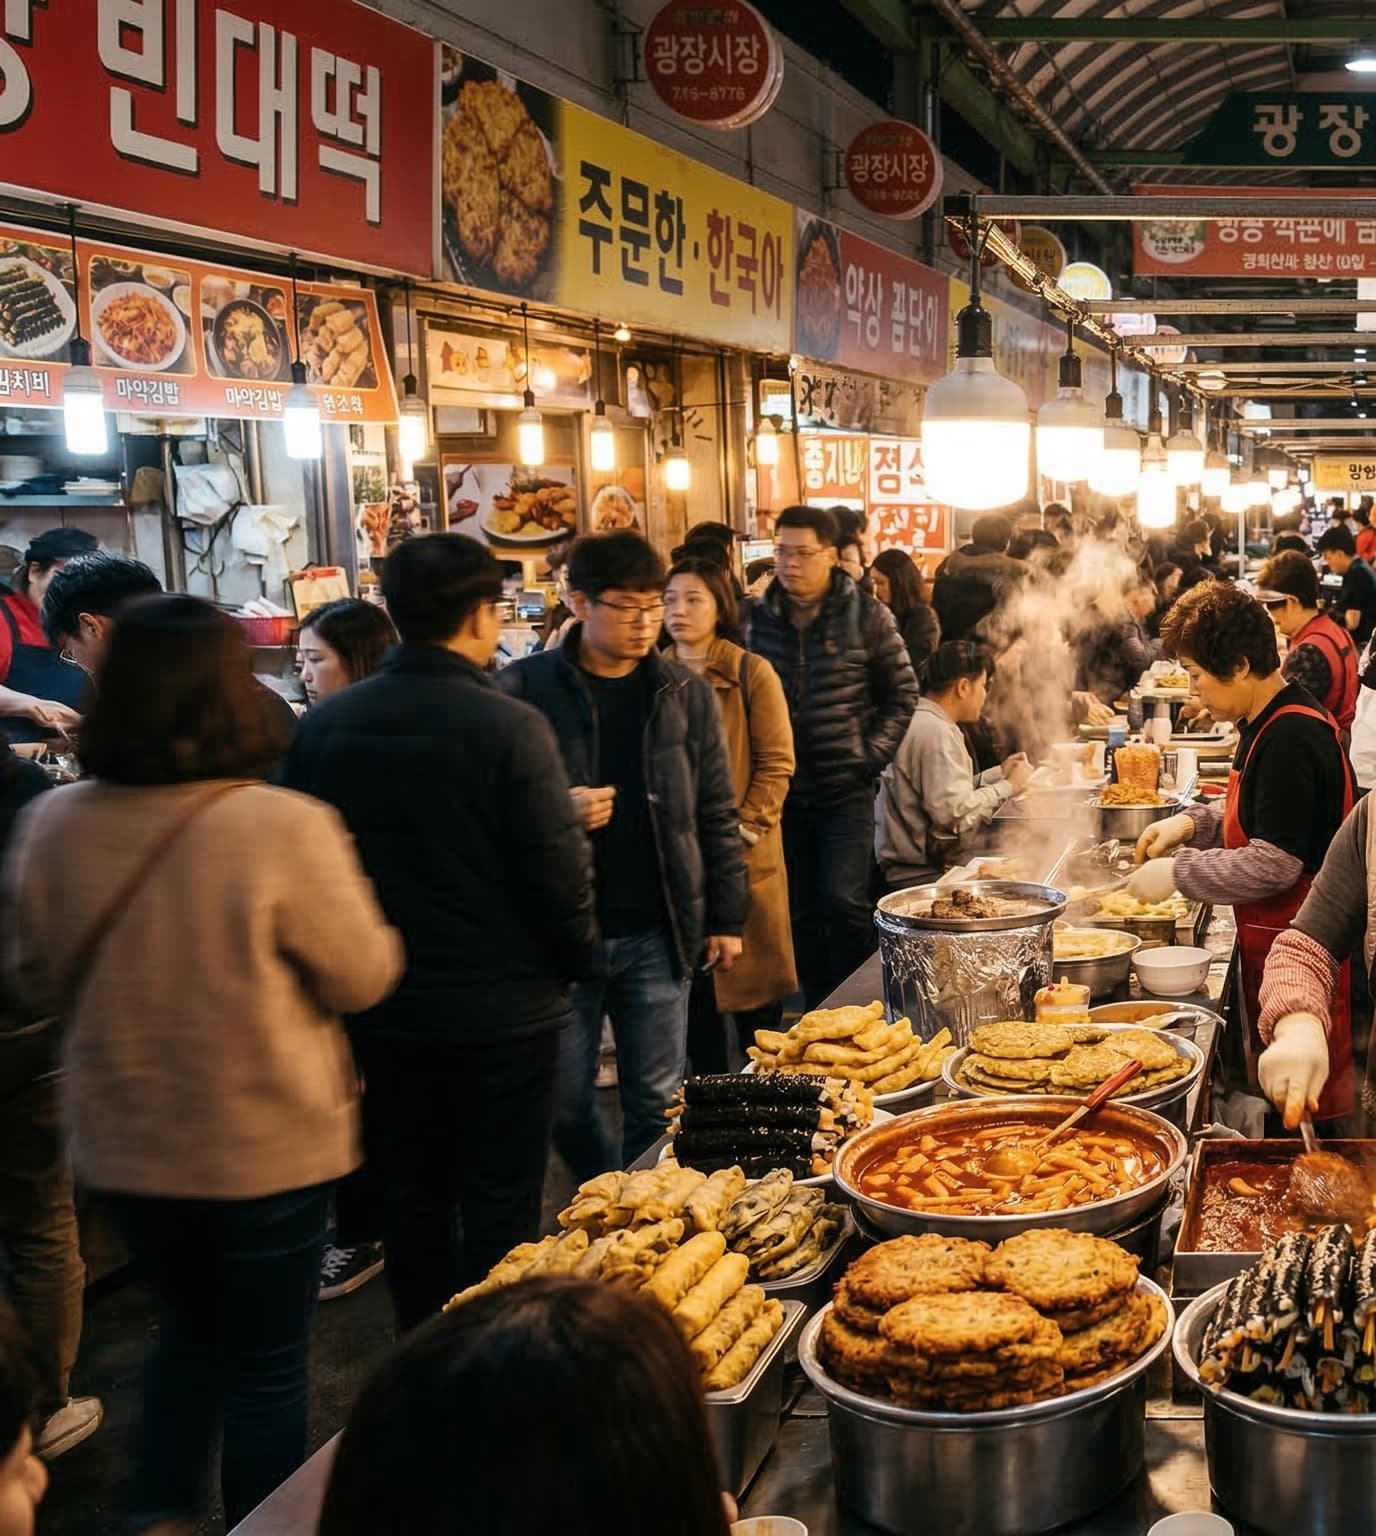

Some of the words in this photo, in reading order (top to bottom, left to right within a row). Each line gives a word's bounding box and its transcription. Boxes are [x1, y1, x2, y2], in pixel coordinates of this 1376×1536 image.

[652, 34, 762, 75] 광장시장
[97, 0, 381, 226] 빈대떡
[850, 152, 929, 184] 광장시장
